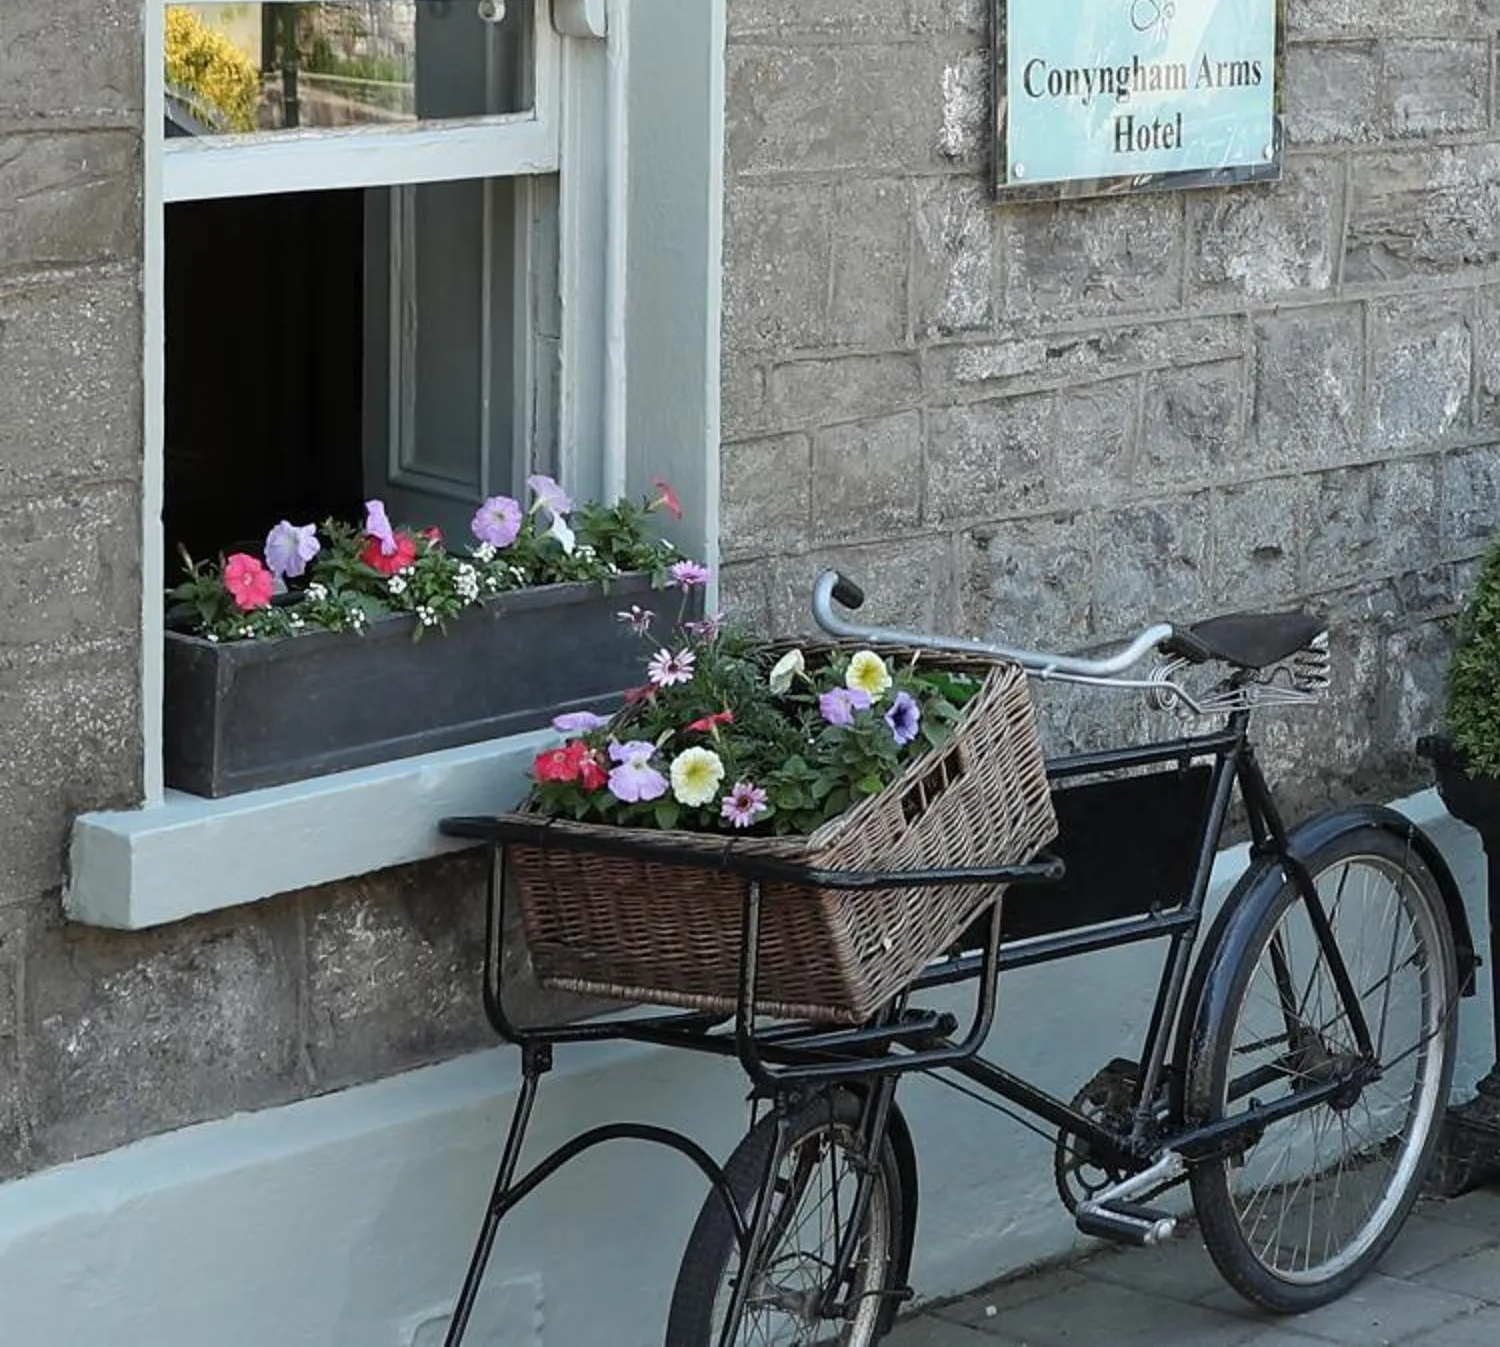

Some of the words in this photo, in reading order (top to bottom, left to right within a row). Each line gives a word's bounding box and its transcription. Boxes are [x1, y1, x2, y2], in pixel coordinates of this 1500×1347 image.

[1022, 54, 1189, 106] Conyngham
[1194, 52, 1263, 90] Arms
[1112, 112, 1183, 153] Hotel
